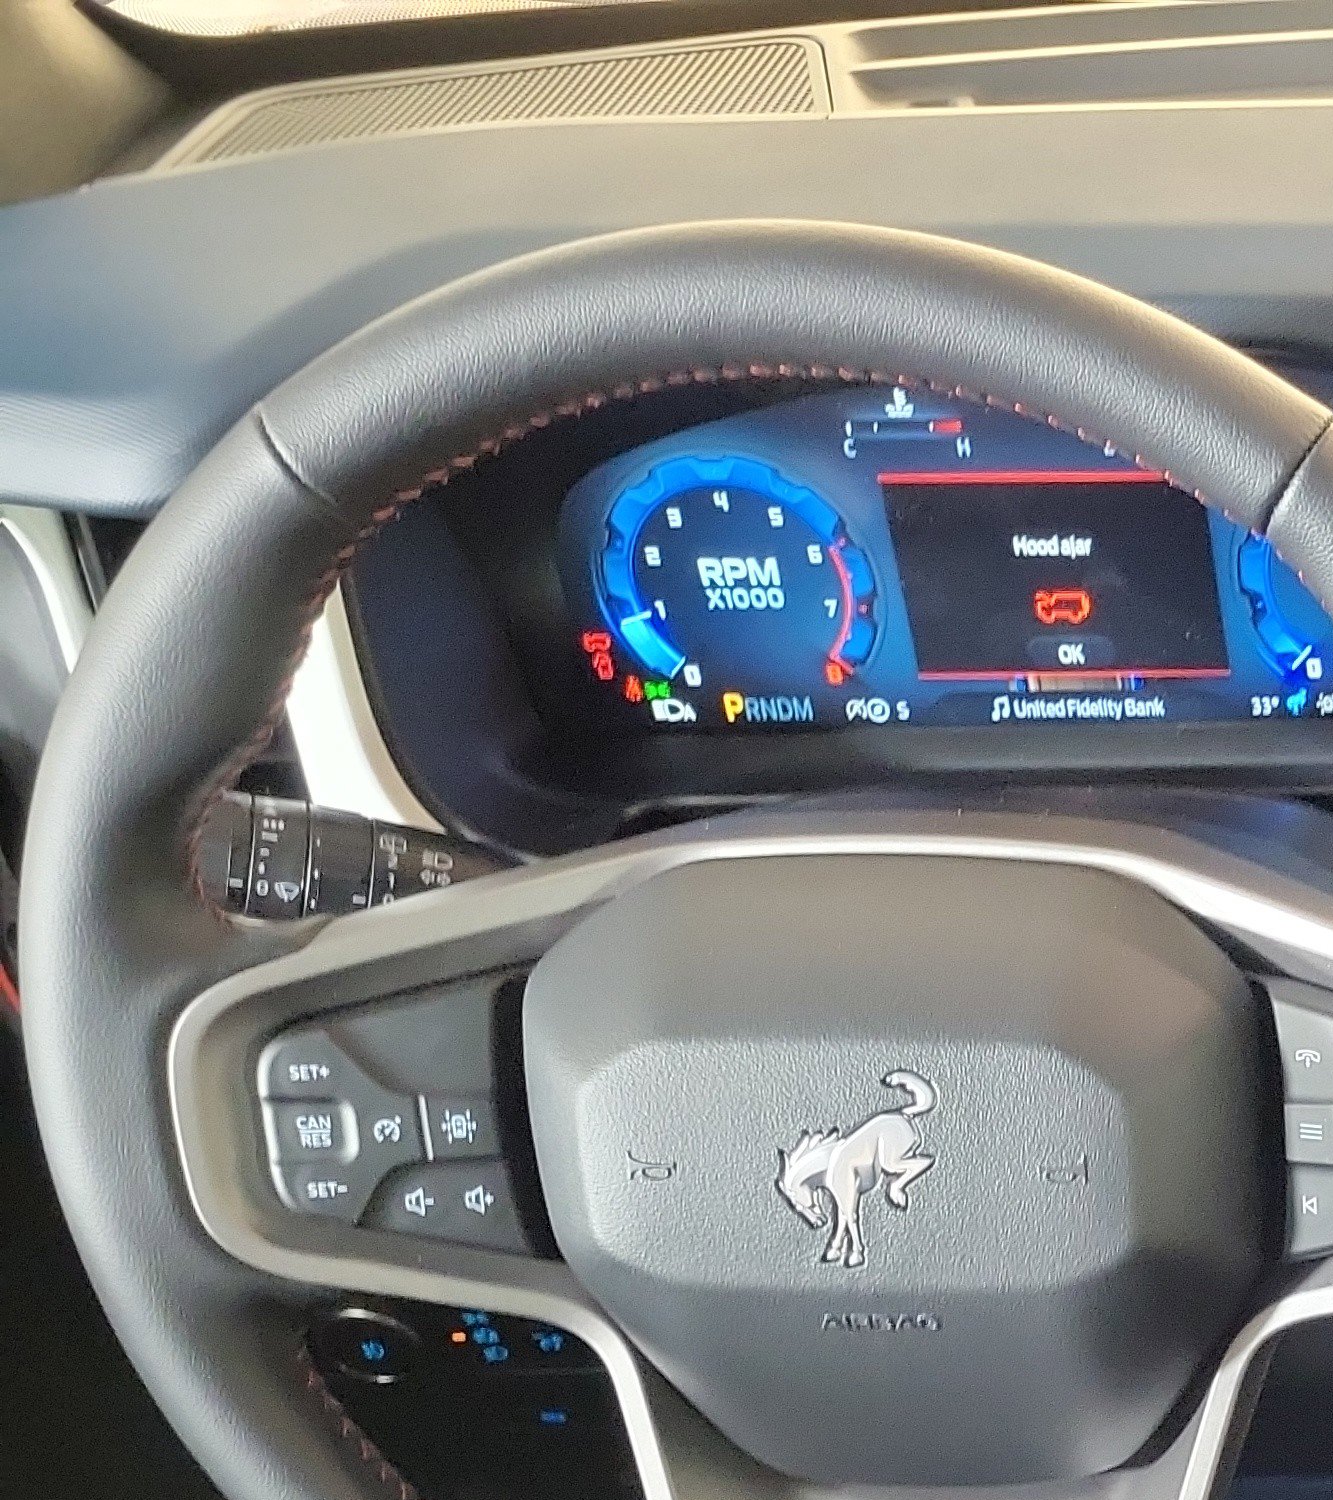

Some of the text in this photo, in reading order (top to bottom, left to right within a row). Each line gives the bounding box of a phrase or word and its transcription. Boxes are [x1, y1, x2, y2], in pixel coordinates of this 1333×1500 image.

[843, 437, 857, 459] C
[956, 437, 971, 458] H
[713, 491, 730, 513] 4
[644, 546, 662, 568] 2
[1012, 533, 1092, 560] Hood ajar
[697, 557, 780, 587] RPM
[706, 587, 785, 611] X1000
[1058, 643, 1086, 665] OK
[1013, 696, 1166, 721] United Fidelity Bank
[289, 1064, 330, 1082] SET+
[296, 1114, 332, 1130] CAN
[301, 1133, 332, 1149] RES
